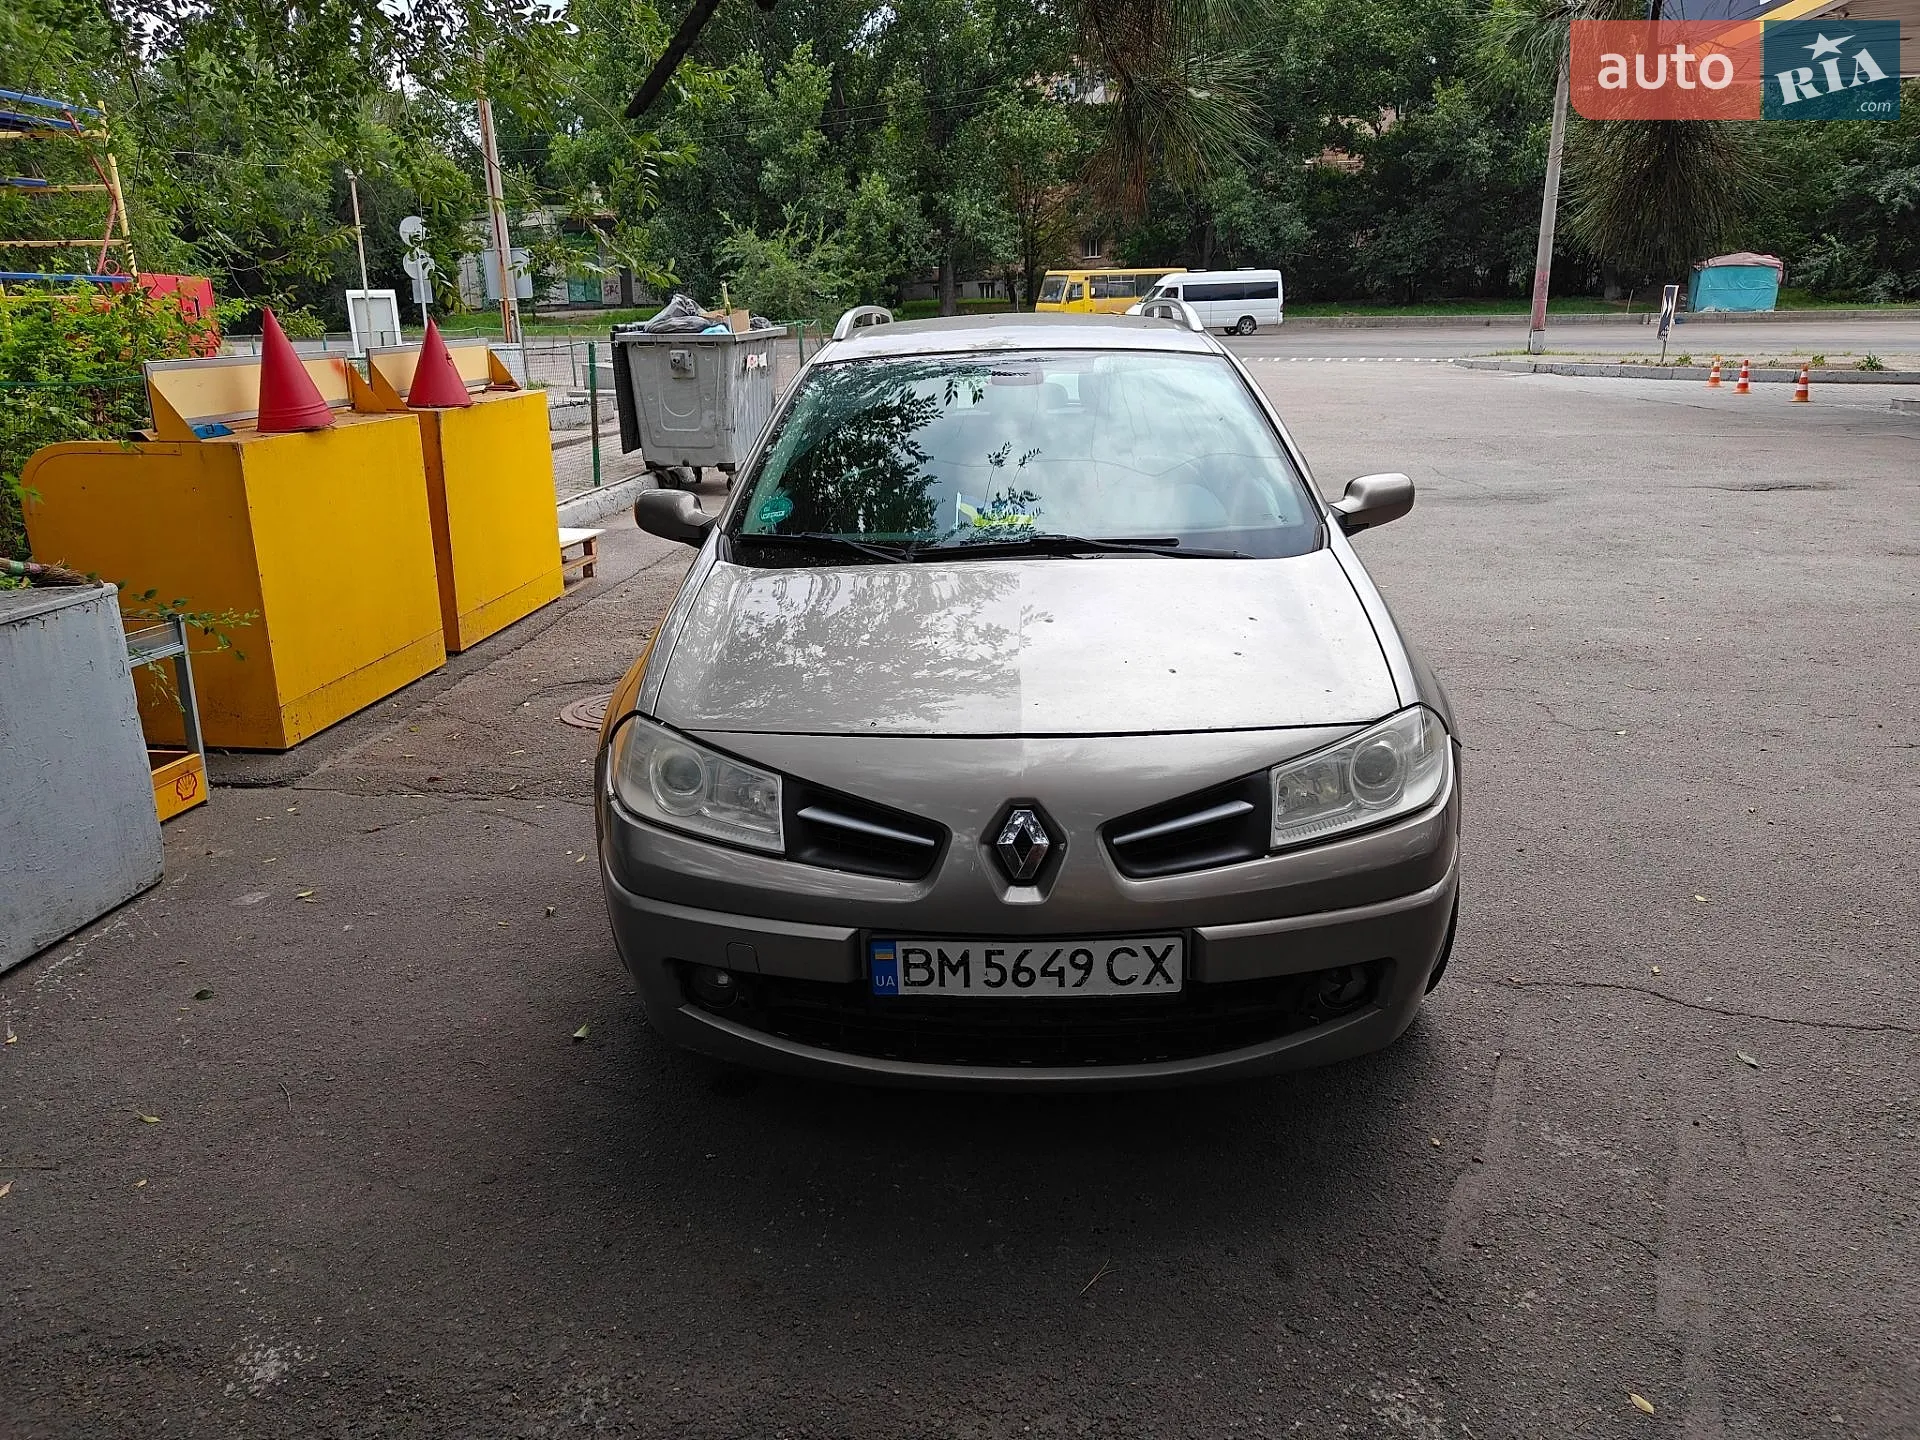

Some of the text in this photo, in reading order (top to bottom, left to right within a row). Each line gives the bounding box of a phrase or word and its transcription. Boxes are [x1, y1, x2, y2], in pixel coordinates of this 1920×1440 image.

[901, 944, 1176, 989] BM 5649 CX
[875, 975, 896, 987] UA
